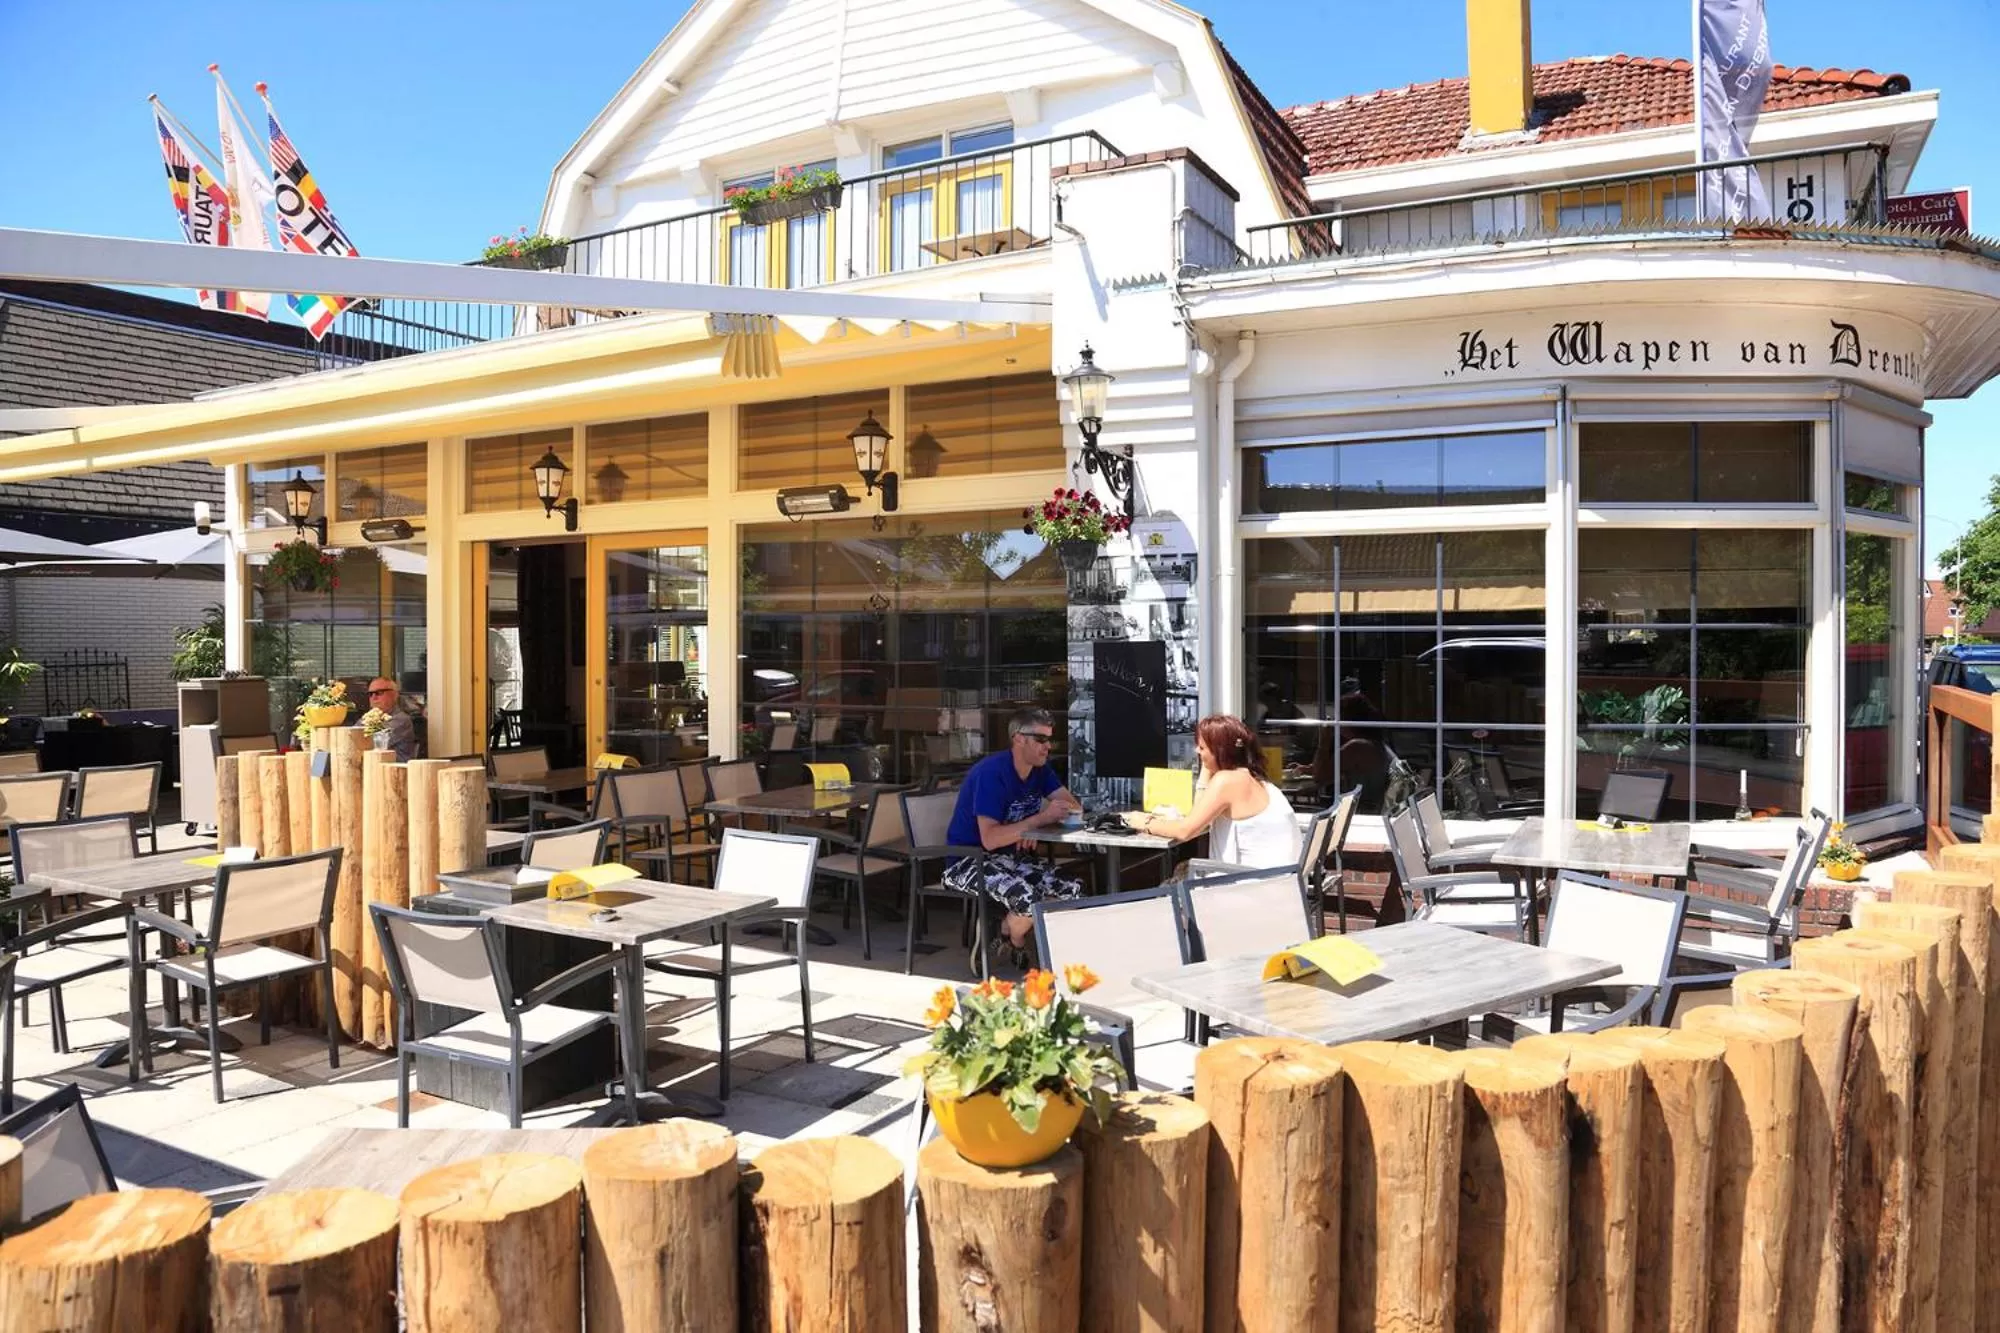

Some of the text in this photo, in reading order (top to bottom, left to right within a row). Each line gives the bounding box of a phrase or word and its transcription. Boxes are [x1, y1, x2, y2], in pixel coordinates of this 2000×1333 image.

[1921, 196, 1956, 210] Café
[1548, 320, 1710, 370] Wapen
[1741, 341, 1807, 365] van
